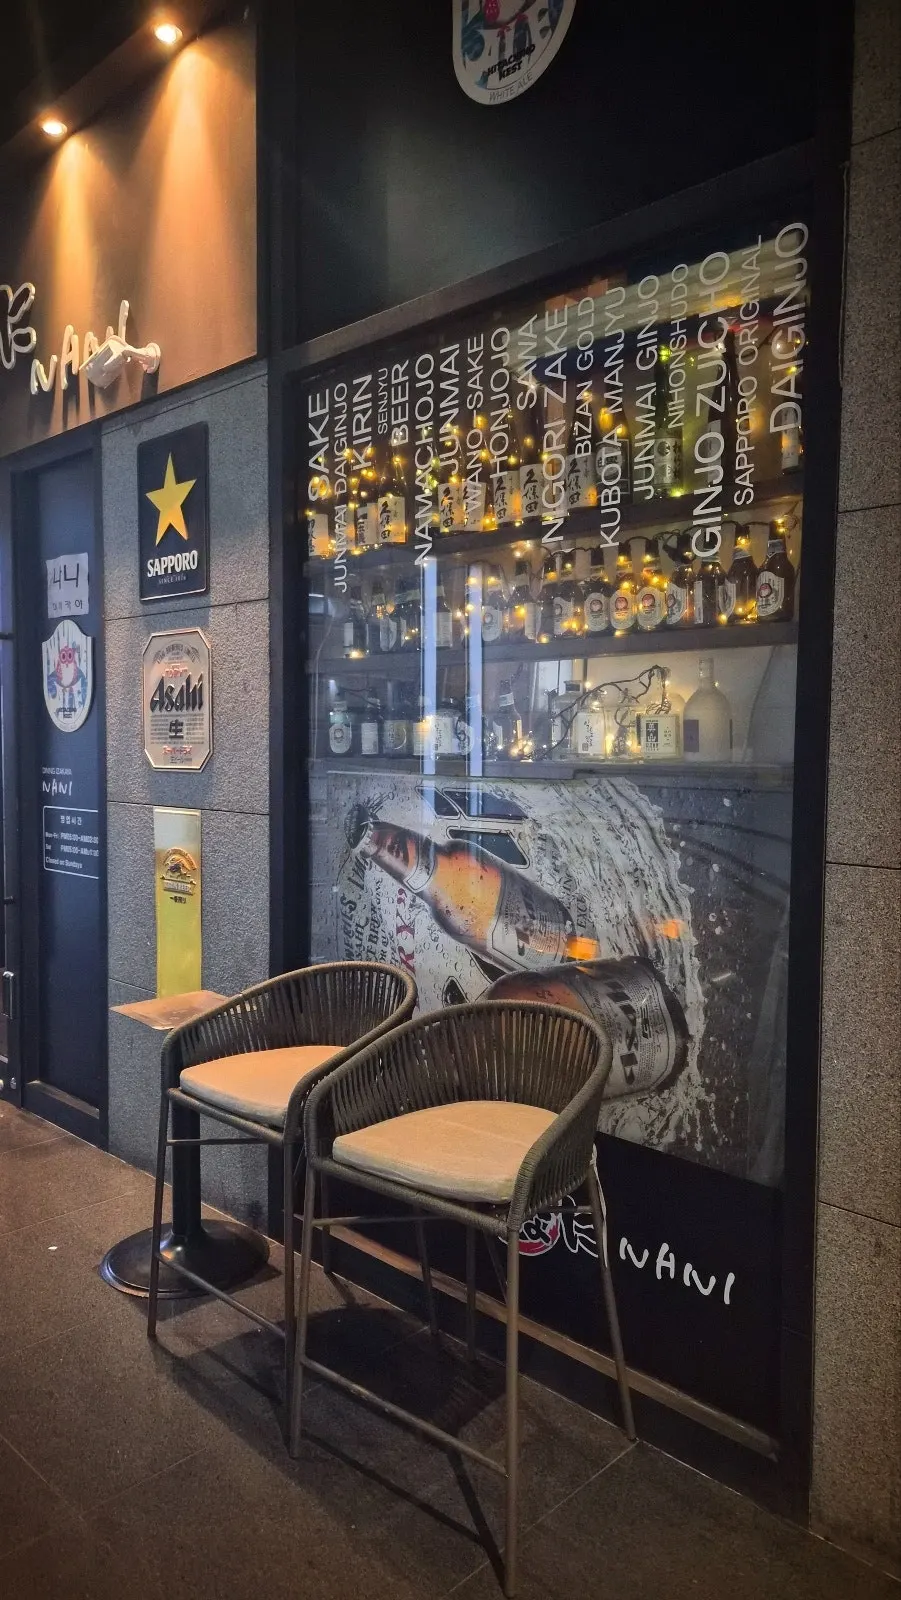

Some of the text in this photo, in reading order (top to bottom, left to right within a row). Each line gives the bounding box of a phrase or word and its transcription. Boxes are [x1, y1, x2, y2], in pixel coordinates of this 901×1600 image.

[489, 73, 534, 102] WHITE ALE
[574, 296, 595, 459] BIZAN GOLD
[604, 286, 626, 415] MANJYU
[633, 274, 660, 501] JUNMAI GINJO
[667, 263, 689, 430] NIHONSHUDO
[733, 234, 762, 506] SAPPORO ORIGINAL
[770, 222, 809, 433] DAIGINJO
[308, 388, 330, 502] SAKE
[352, 374, 373, 471] KIRIN
[377, 367, 389, 435] SENJYU
[391, 359, 410, 447] BEER
[414, 353, 435, 566] NAMACHOJO
[439, 343, 460, 475] JUNMAI
[490, 327, 510, 479] HONJOJO
[541, 304, 569, 544] NIGORI ZAKE
[691, 251, 730, 559] GINJO ZUICHO
[334, 382, 348, 593] JUNMAI DAIGINJO
[600, 423, 624, 549] KUBOTA
[53, 563, 80, 590] 44
[147, 550, 198, 577] SAPPORO
[150, 672, 203, 712] Asahi
[169, 719, 184, 739] 生
[42, 779, 72, 796] NANI
[619, 1237, 735, 1305] NANI
